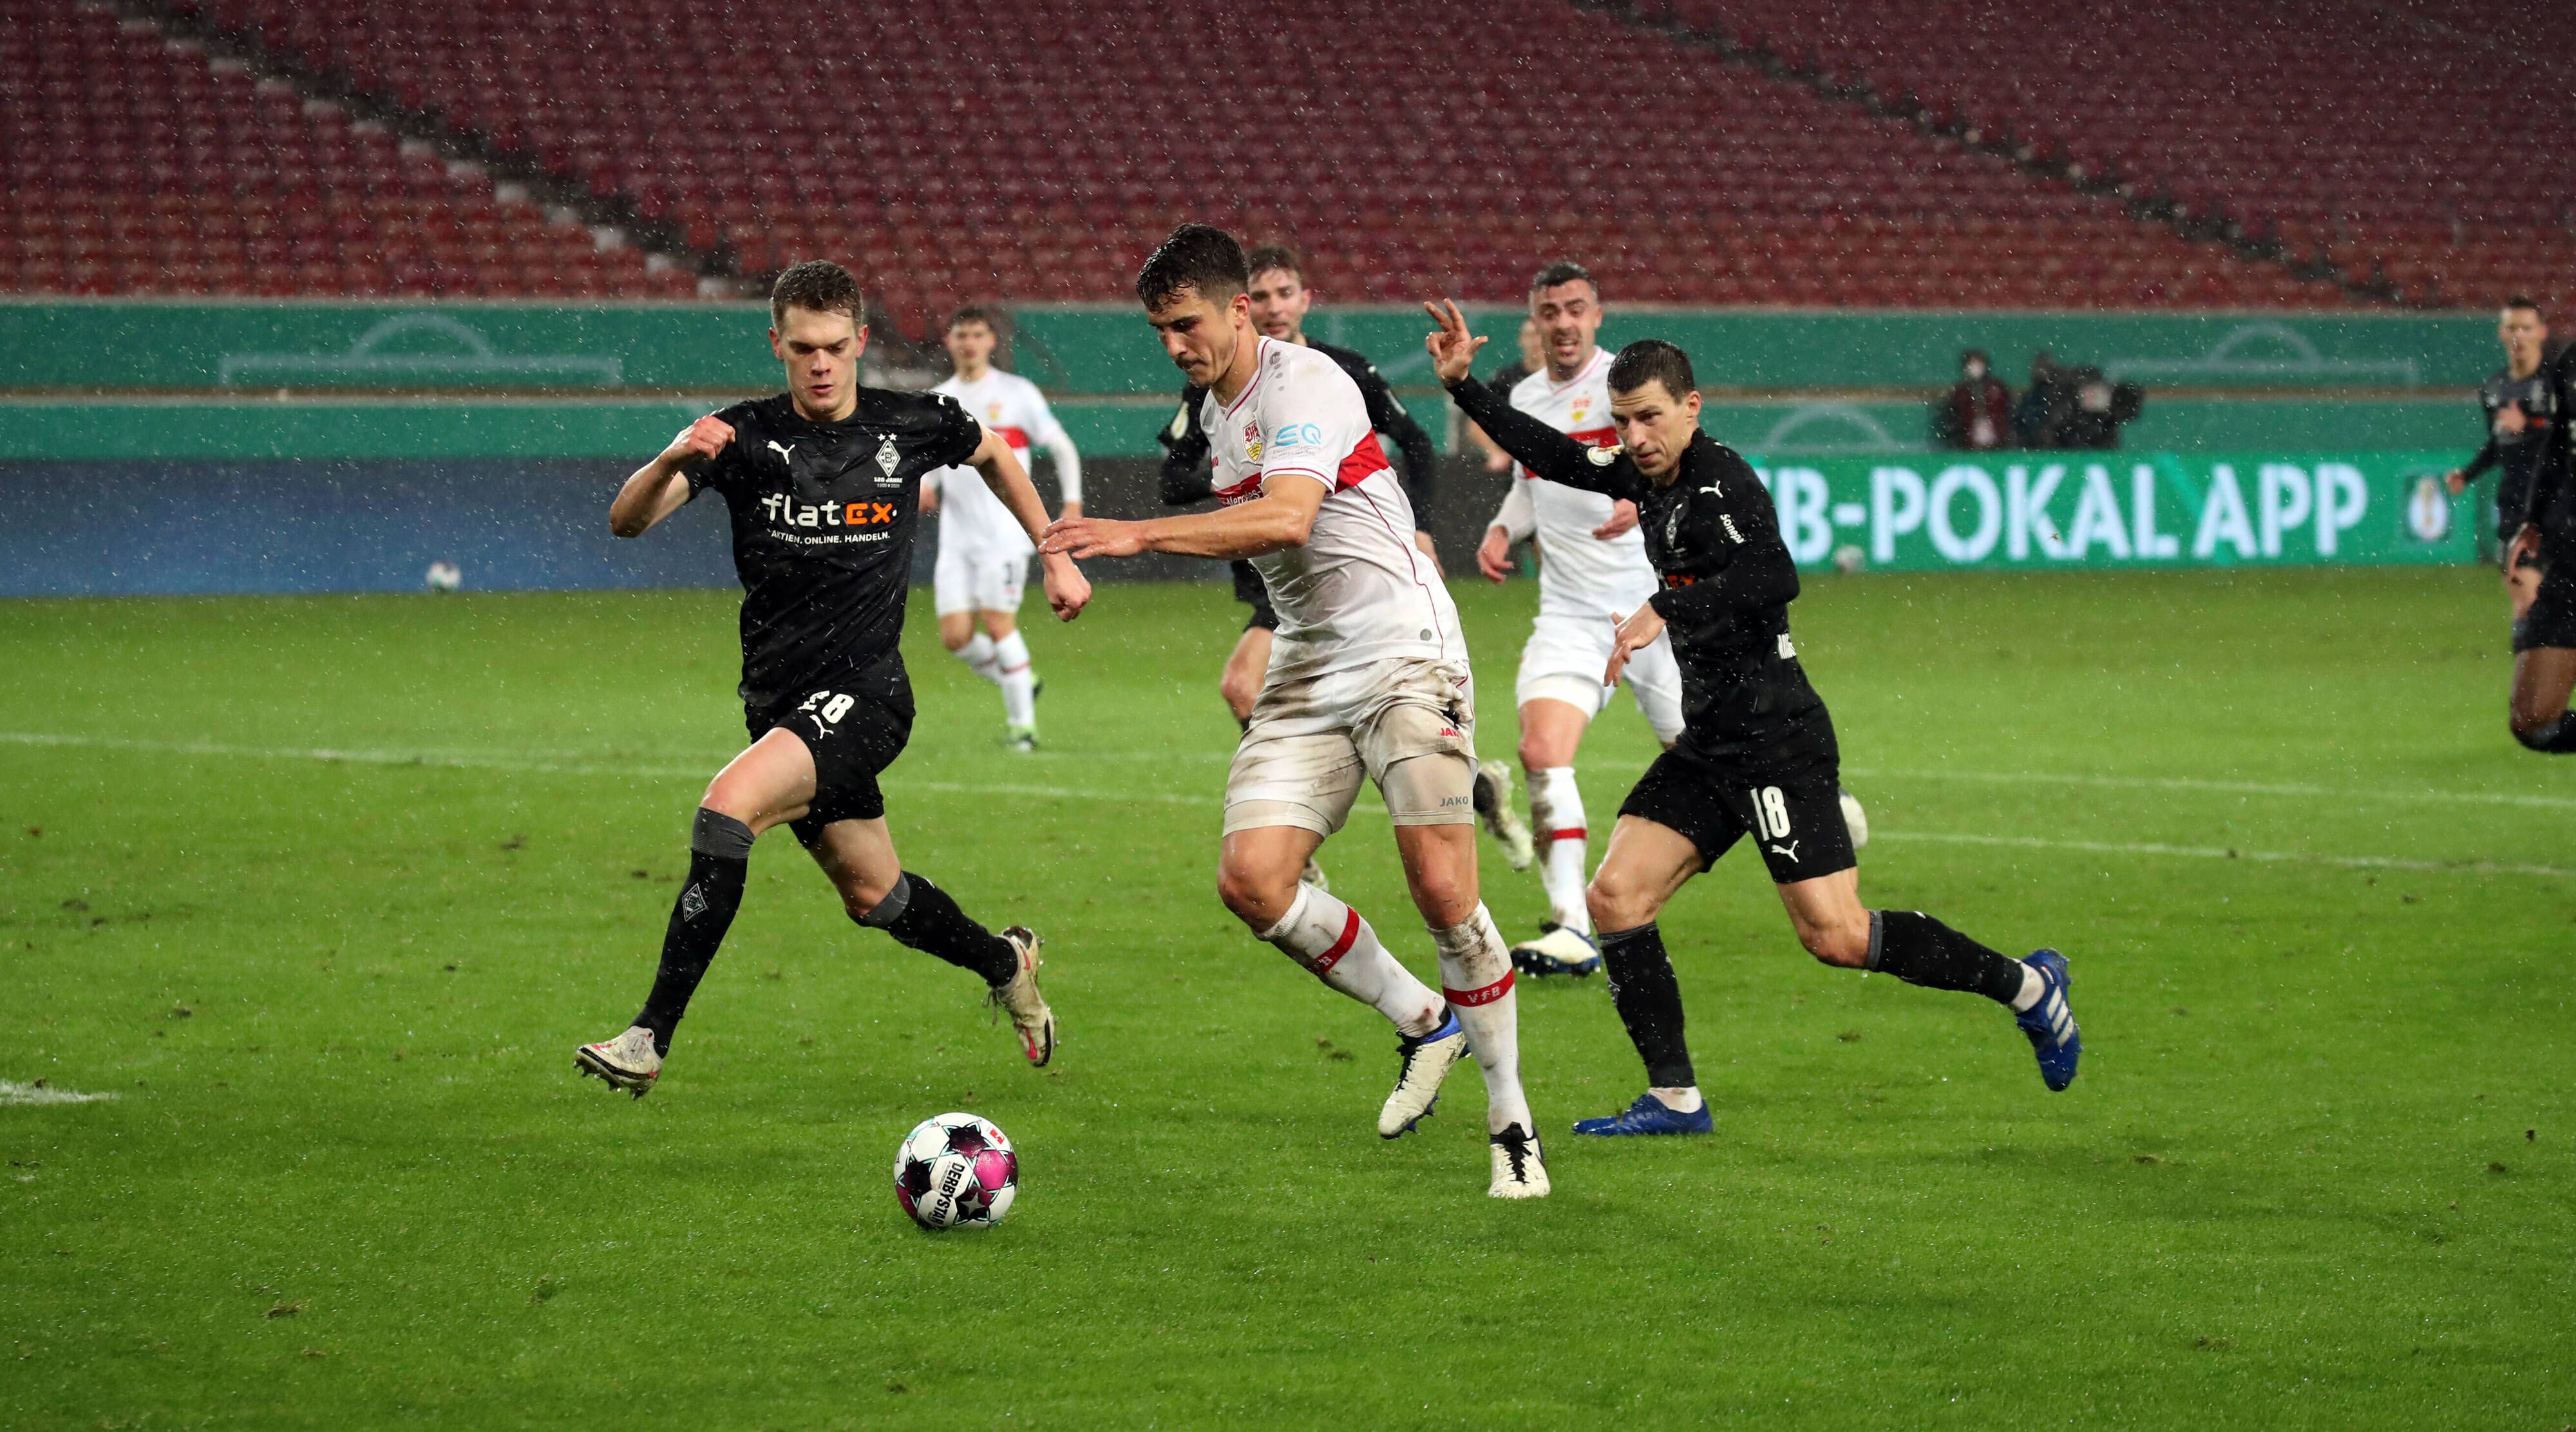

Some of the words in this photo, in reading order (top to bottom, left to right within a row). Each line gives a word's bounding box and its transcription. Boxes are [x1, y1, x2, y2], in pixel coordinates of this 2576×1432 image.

[1274, 423, 1321, 446] EQ
[1756, 464, 2179, 564] B-POKAL
[2192, 463, 2367, 558] APP
[771, 530, 802, 544] AKTIEN.
[804, 535, 842, 545] ONLINE.
[844, 531, 890, 543] HANDELN.
[1439, 795, 1468, 807] JAKO
[1750, 786, 1790, 842] 18
